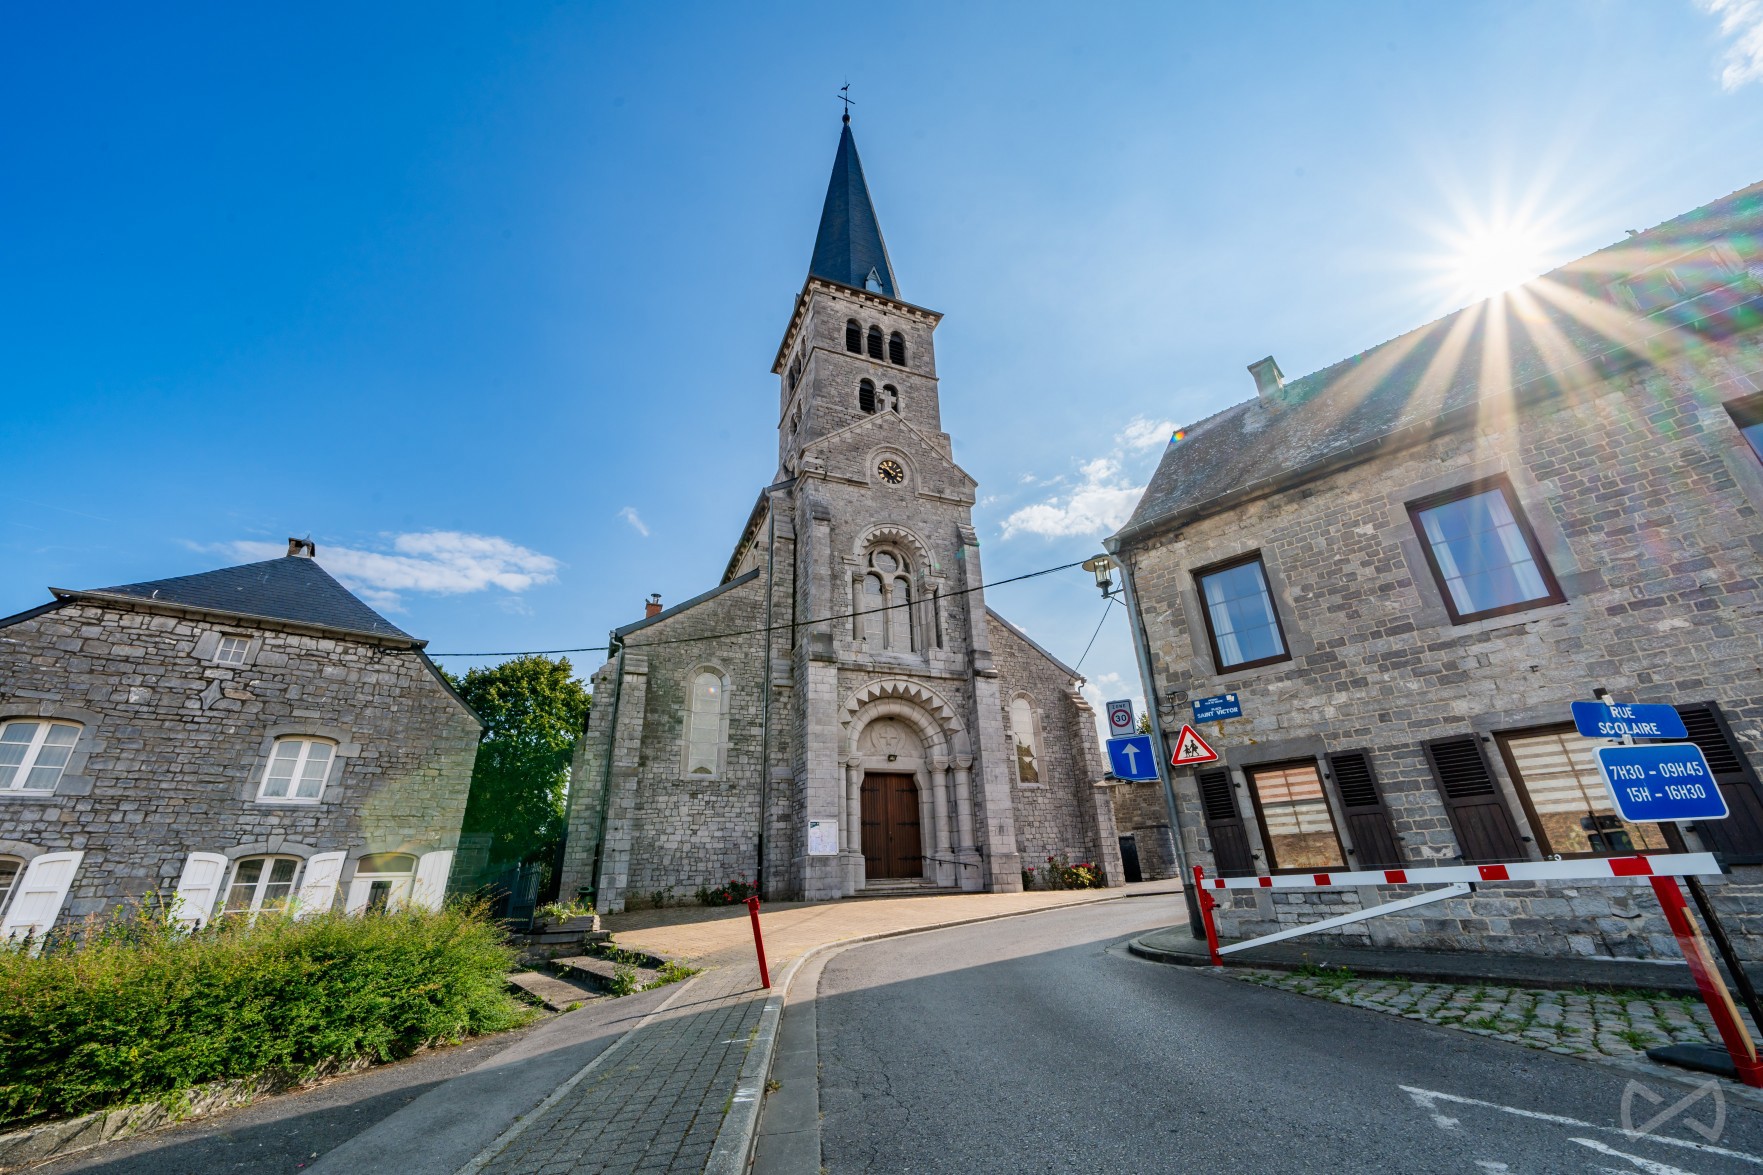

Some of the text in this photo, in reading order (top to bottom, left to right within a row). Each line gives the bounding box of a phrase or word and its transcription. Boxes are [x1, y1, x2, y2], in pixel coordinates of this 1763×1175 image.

[1115, 714, 1127, 722] 30
[1197, 706, 1239, 719] SAINT VICTOR
[1610, 706, 1636, 719] RUE
[1598, 722, 1661, 735] SCOLAIRE
[1609, 764, 1645, 781] 7H30
[1659, 761, 1704, 778] 09H45
[1626, 786, 1652, 802] 15H
[1665, 783, 1706, 800] 16H30
